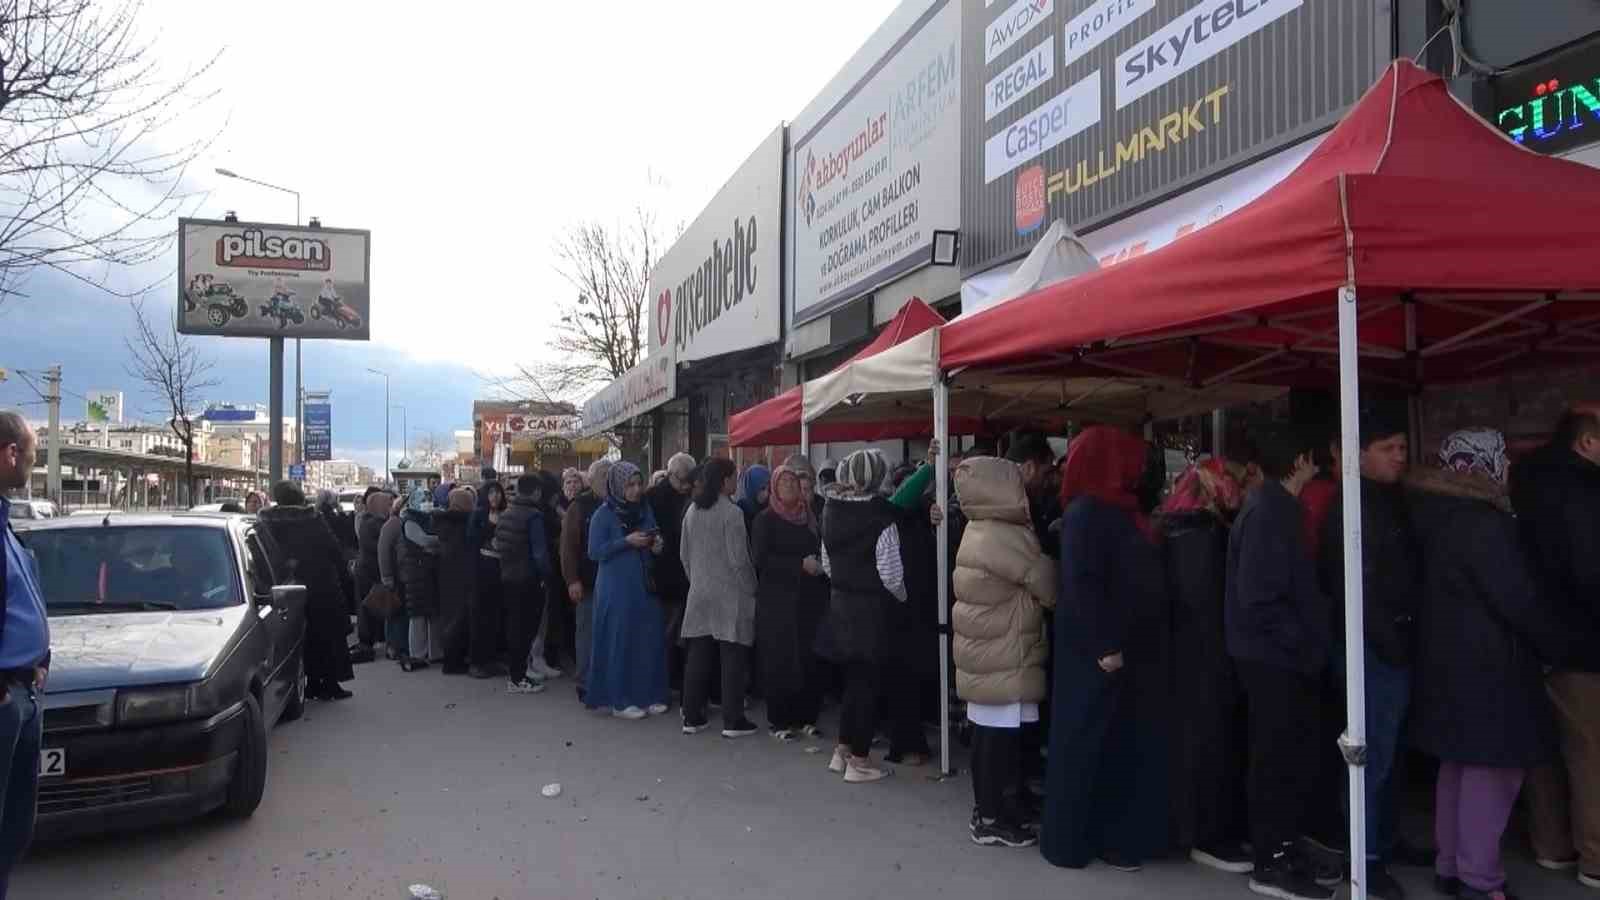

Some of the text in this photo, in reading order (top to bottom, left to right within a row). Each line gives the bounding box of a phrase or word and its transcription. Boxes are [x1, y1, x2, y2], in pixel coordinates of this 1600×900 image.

[895, 43, 955, 121] ARFEM
[994, 52, 1047, 107] REGAL
[1005, 98, 1072, 159] Casper
[1047, 86, 1229, 205] FULLMARKT
[862, 192, 881, 222] CAM
[882, 162, 921, 207] BALKON
[222, 230, 324, 262] pilsan
[827, 235, 867, 273] DOĞRAMA
[868, 199, 919, 251] PROFİLLERİ
[100, 395, 116, 408] bp
[527, 418, 558, 431] CAN
